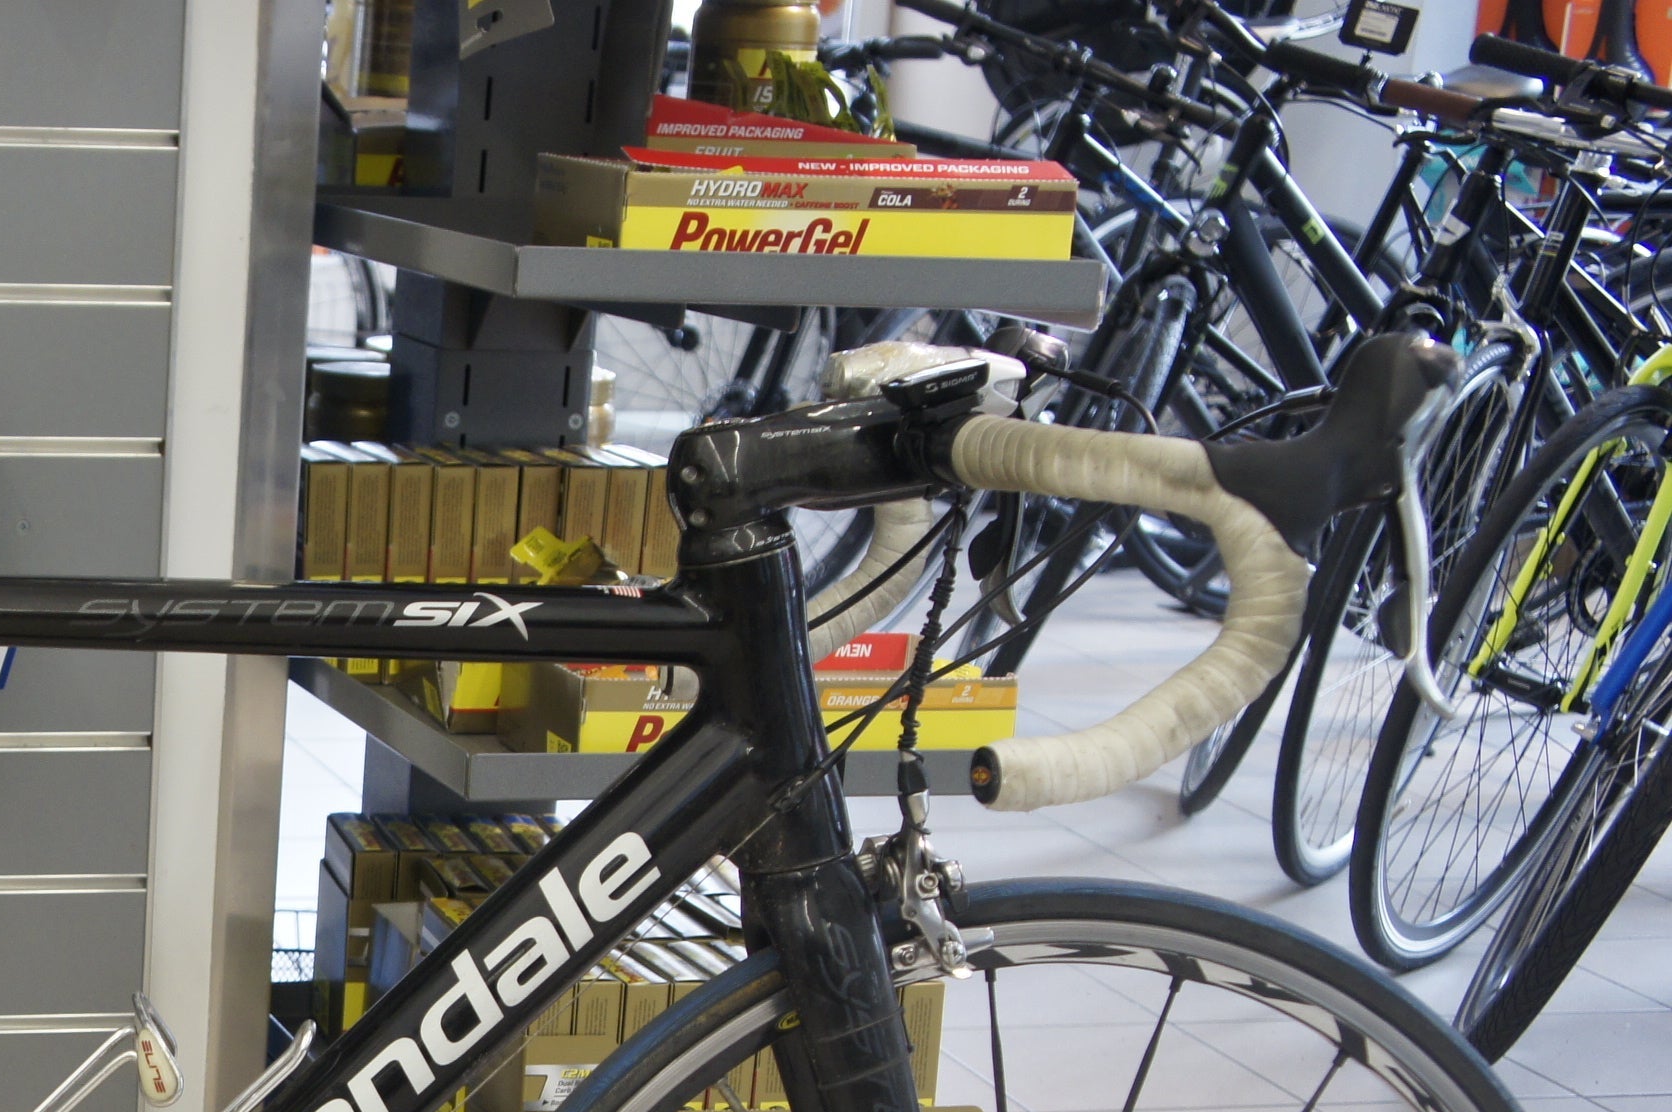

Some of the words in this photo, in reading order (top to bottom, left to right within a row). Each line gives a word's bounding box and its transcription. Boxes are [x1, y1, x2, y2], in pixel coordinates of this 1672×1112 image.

[656, 123, 728, 138] IMPROVED
[730, 125, 804, 140] PACKAGING
[798, 162, 836, 171] NEW
[849, 163, 934, 173] IMPROVED
[938, 164, 1029, 175] PACKAGING
[690, 180, 808, 198] HYDROMAX
[1017, 186, 1029, 199] 2
[686, 198, 698, 206] NO
[699, 199, 726, 207] EXTRA
[727, 199, 754, 208] WATER
[754, 200, 788, 208] NEEDED
[878, 195, 912, 207] COLA
[670, 211, 871, 256] PowerGel
[961, 685, 971, 697] 2
